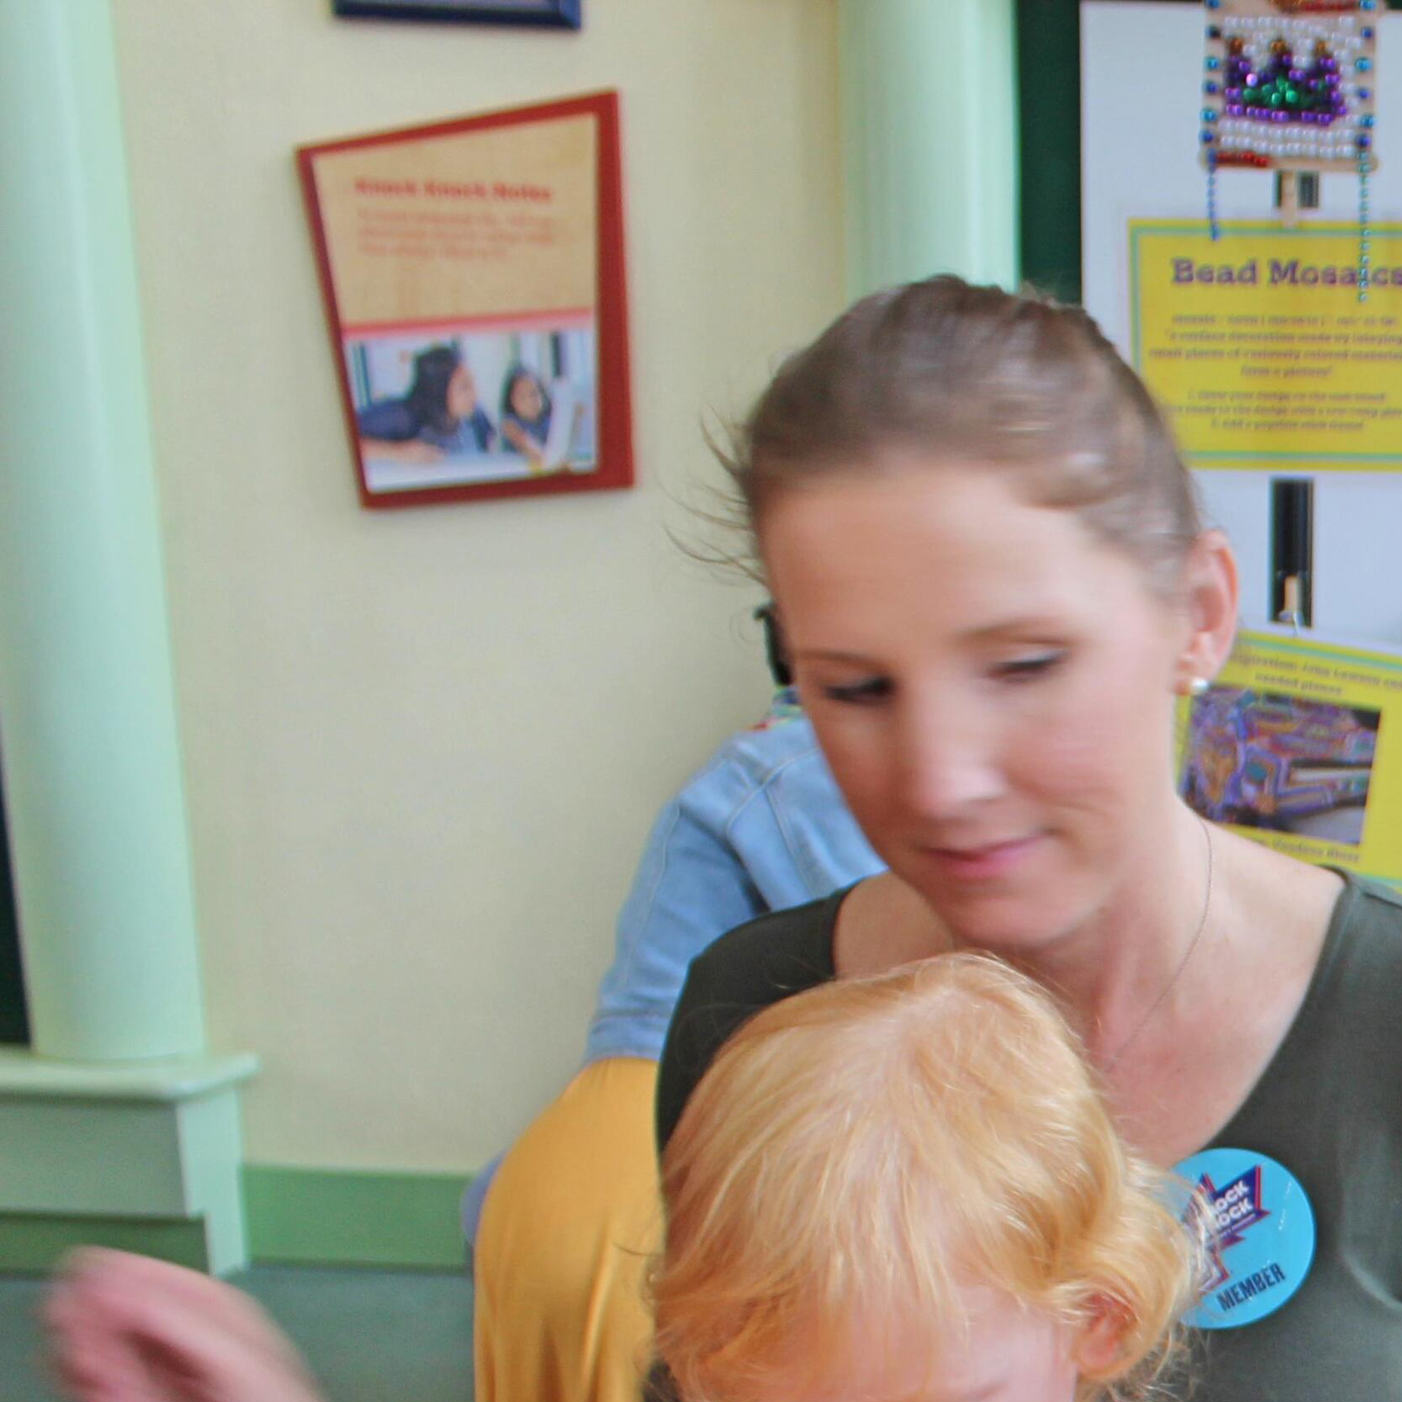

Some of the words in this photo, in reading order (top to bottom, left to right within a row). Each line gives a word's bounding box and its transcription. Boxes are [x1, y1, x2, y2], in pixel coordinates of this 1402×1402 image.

[1172, 257, 1258, 285] Bead
[1214, 1180, 1249, 1211] OCK
[1216, 1197, 1254, 1230] OCK
[1216, 1262, 1286, 1311] MEMBER
